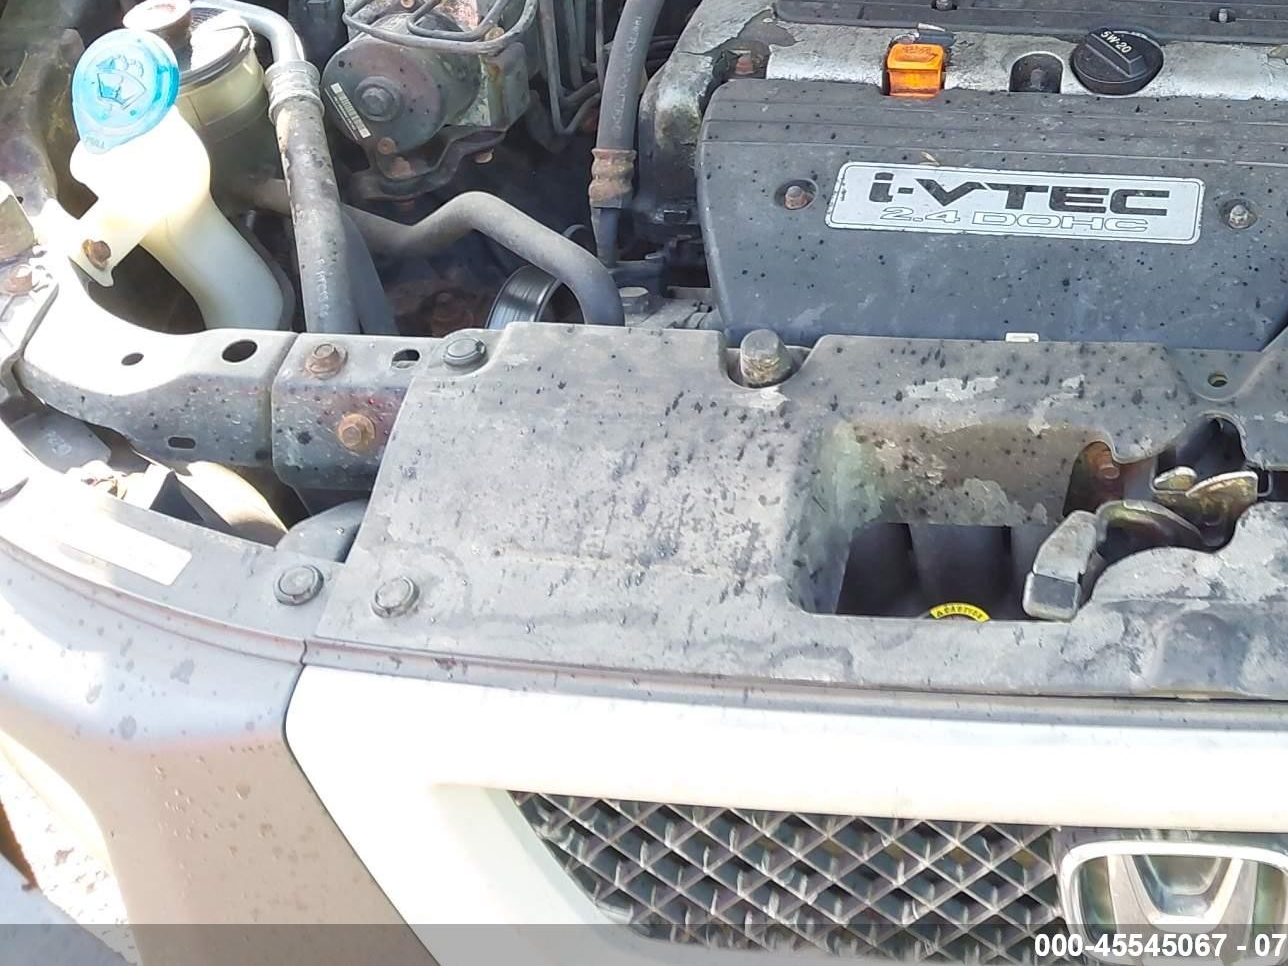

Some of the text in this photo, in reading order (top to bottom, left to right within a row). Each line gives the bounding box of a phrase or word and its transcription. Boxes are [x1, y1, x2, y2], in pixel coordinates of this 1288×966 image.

[1100, 30, 1132, 54] 5W-20
[868, 171, 1170, 217] i-VTEC
[879, 206, 1149, 232] 2.4 DOHC
